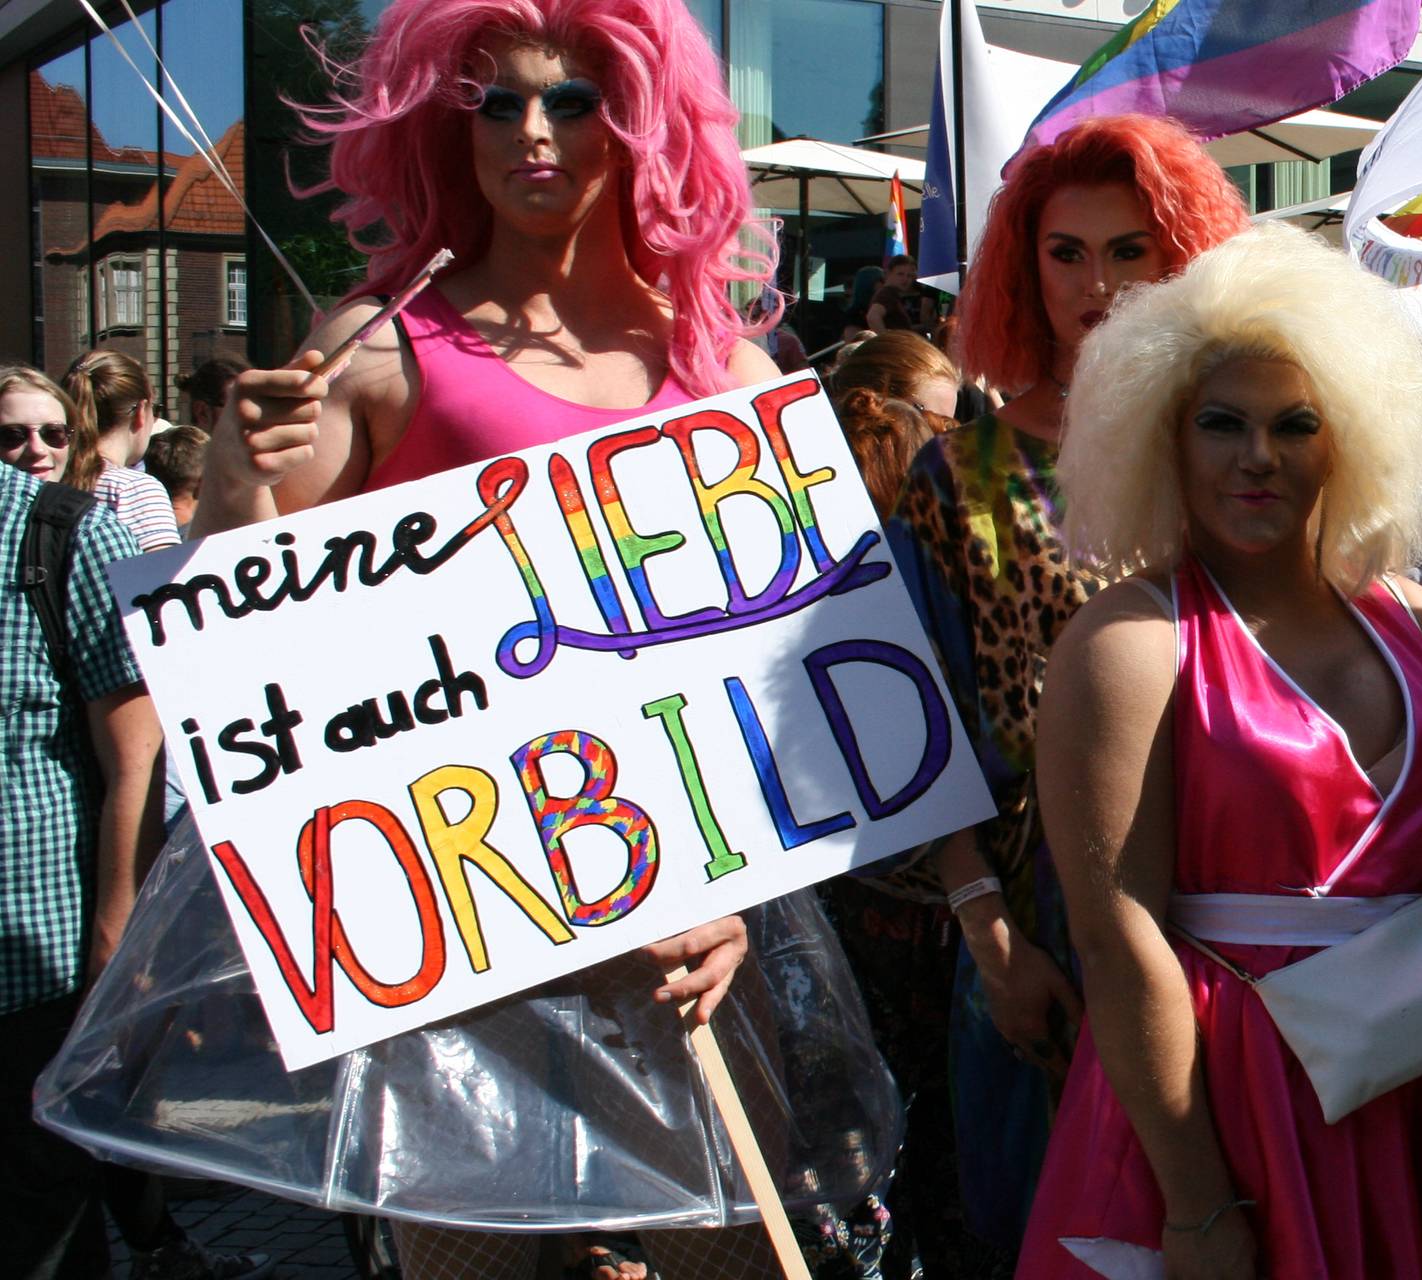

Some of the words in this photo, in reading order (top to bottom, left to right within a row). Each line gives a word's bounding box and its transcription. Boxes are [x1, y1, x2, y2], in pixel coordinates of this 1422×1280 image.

[131, 510, 470, 647] meine
[476, 377, 892, 679] LIEBE
[181, 683, 303, 803] ist
[323, 634, 489, 753] auch
[211, 638, 953, 1035] VORBILD
